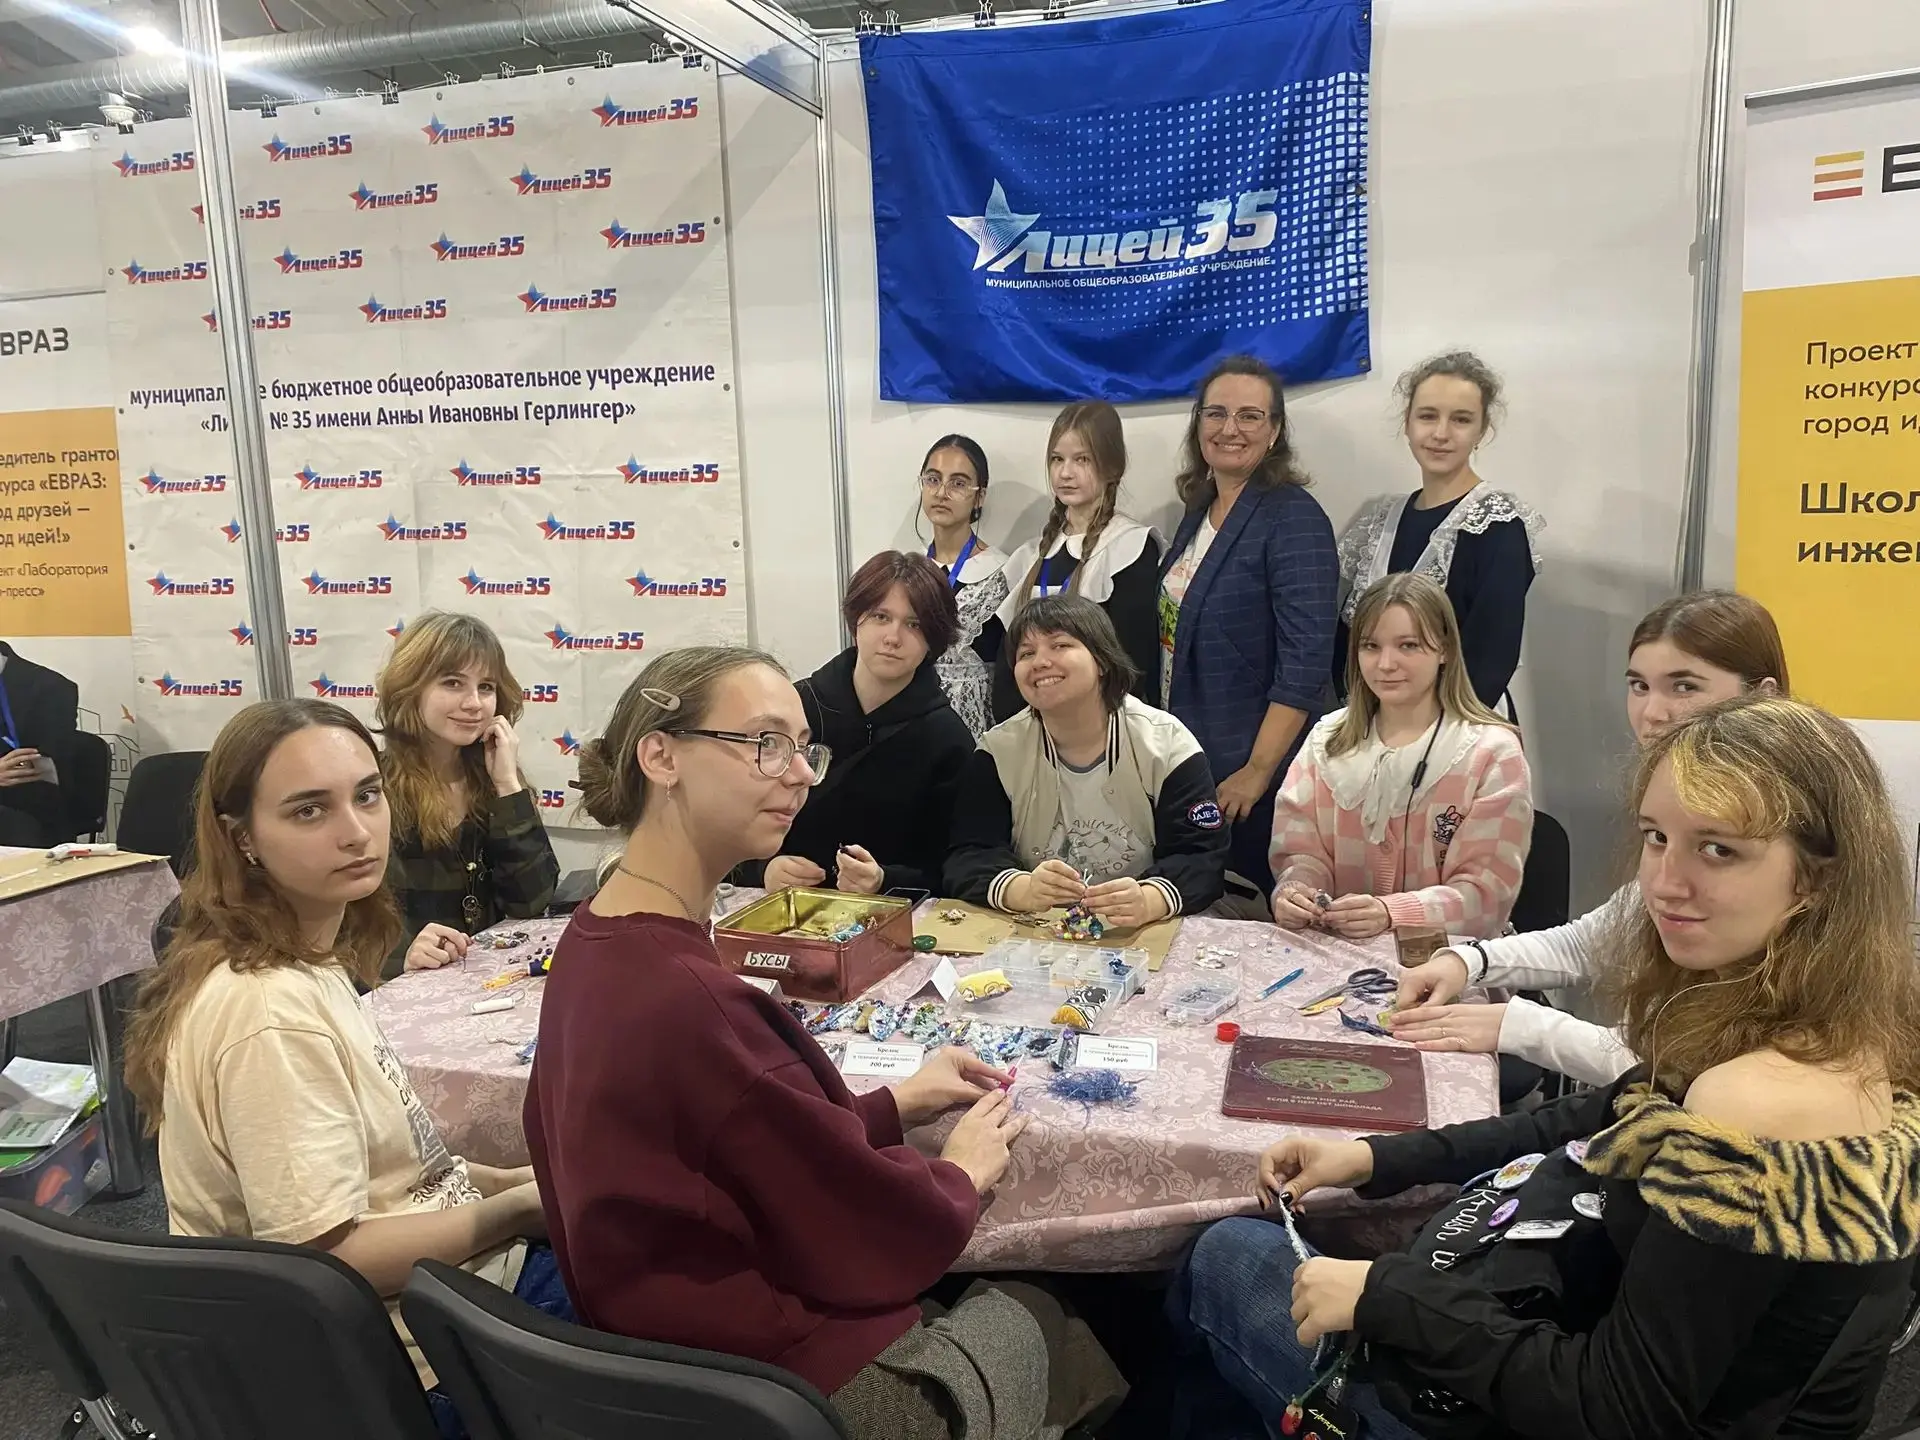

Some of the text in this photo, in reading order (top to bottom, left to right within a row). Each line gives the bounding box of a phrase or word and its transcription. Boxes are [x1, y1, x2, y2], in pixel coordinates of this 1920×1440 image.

[986, 256, 1272, 289] МУНИЦИПАЛЬНОЕ ОБЩЕОБРАЗОВАТЕЛЬНОЕ УЧРЕЖДЕНИЕ
[1807, 341, 1918, 369] Проект
[272, 376, 373, 401] бюджетное
[377, 369, 581, 396] общеобразовательное
[586, 364, 715, 390] учреждение
[270, 411, 288, 430] №
[292, 409, 312, 429] 35
[316, 410, 371, 429] имени
[377, 406, 423, 426] Анны
[429, 403, 519, 424] Ивановны
[524, 400, 636, 426] Герлингер»
[1804, 416, 1889, 438] город
[39, 472, 107, 491] «ЕВРАЗ:
[17, 501, 71, 521] друзей
[18, 527, 70, 547] идей!»
[1798, 541, 1920, 563] инже
[17, 562, 108, 578] «Лаборатория
